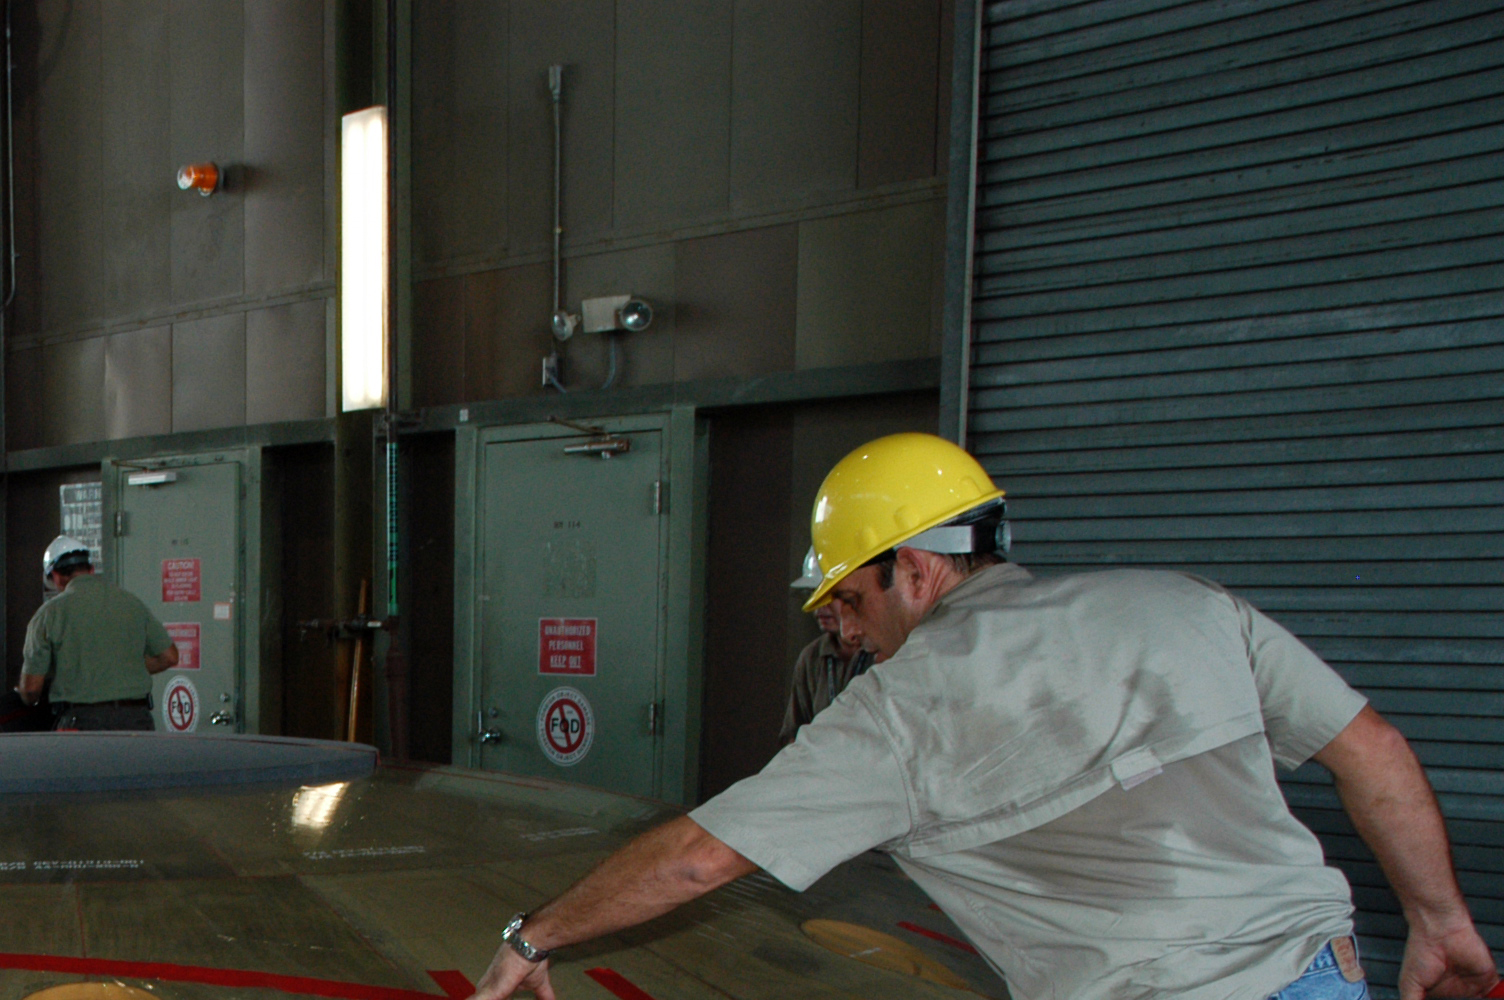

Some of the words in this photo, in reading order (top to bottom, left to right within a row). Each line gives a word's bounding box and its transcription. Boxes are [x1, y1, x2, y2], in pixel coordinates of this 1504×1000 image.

[544, 624, 592, 636] UNAUTHORIZED
[548, 639, 585, 651] PERSONNEL
[550, 655, 567, 666] KEEP
[568, 655, 582, 667] OUT
[171, 701, 192, 715] FOD
[550, 717, 581, 734] FOD
